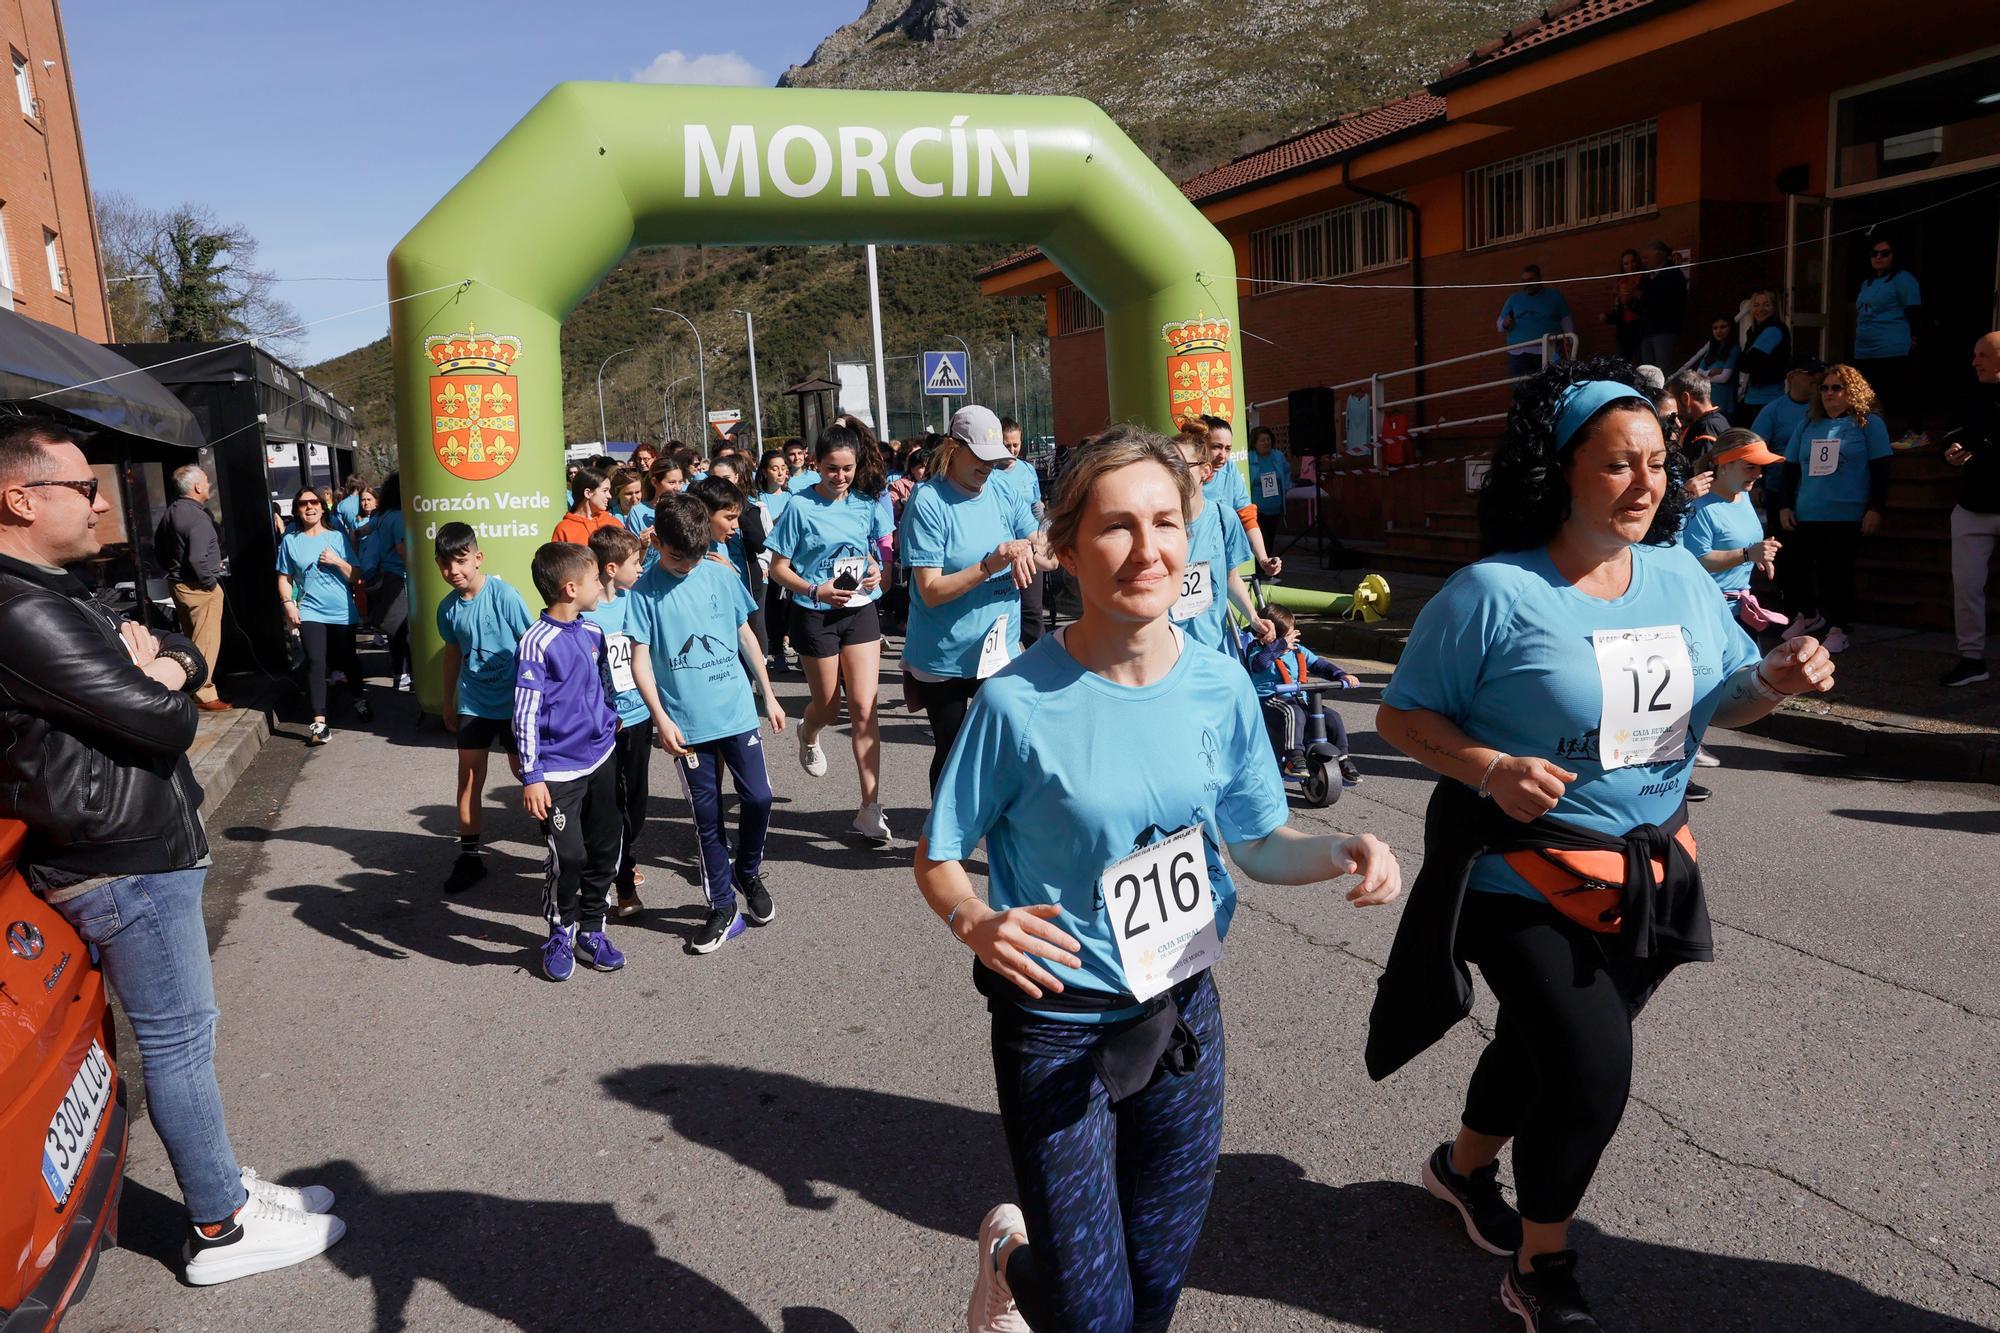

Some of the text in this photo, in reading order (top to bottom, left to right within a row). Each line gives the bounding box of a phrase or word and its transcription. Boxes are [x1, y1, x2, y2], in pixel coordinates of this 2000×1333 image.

[684, 115, 1029, 197] MORCÍN
[1231, 447, 1248, 461] erde
[1820, 446, 1829, 462] 8
[1264, 476, 1274, 488] 79
[412, 491, 550, 512] Corazón Verde
[470, 520, 539, 538] sturias
[609, 642, 631, 669] 24
[1622, 654, 1672, 714] 12
[1638, 778, 1680, 797] mujer
[1162, 838, 1172, 847] LA
[1114, 851, 1199, 940] 216
[1176, 928, 1201, 944] RURAL
[47, 1083, 91, 1171] 3304
[78, 1043, 107, 1105] LCC
